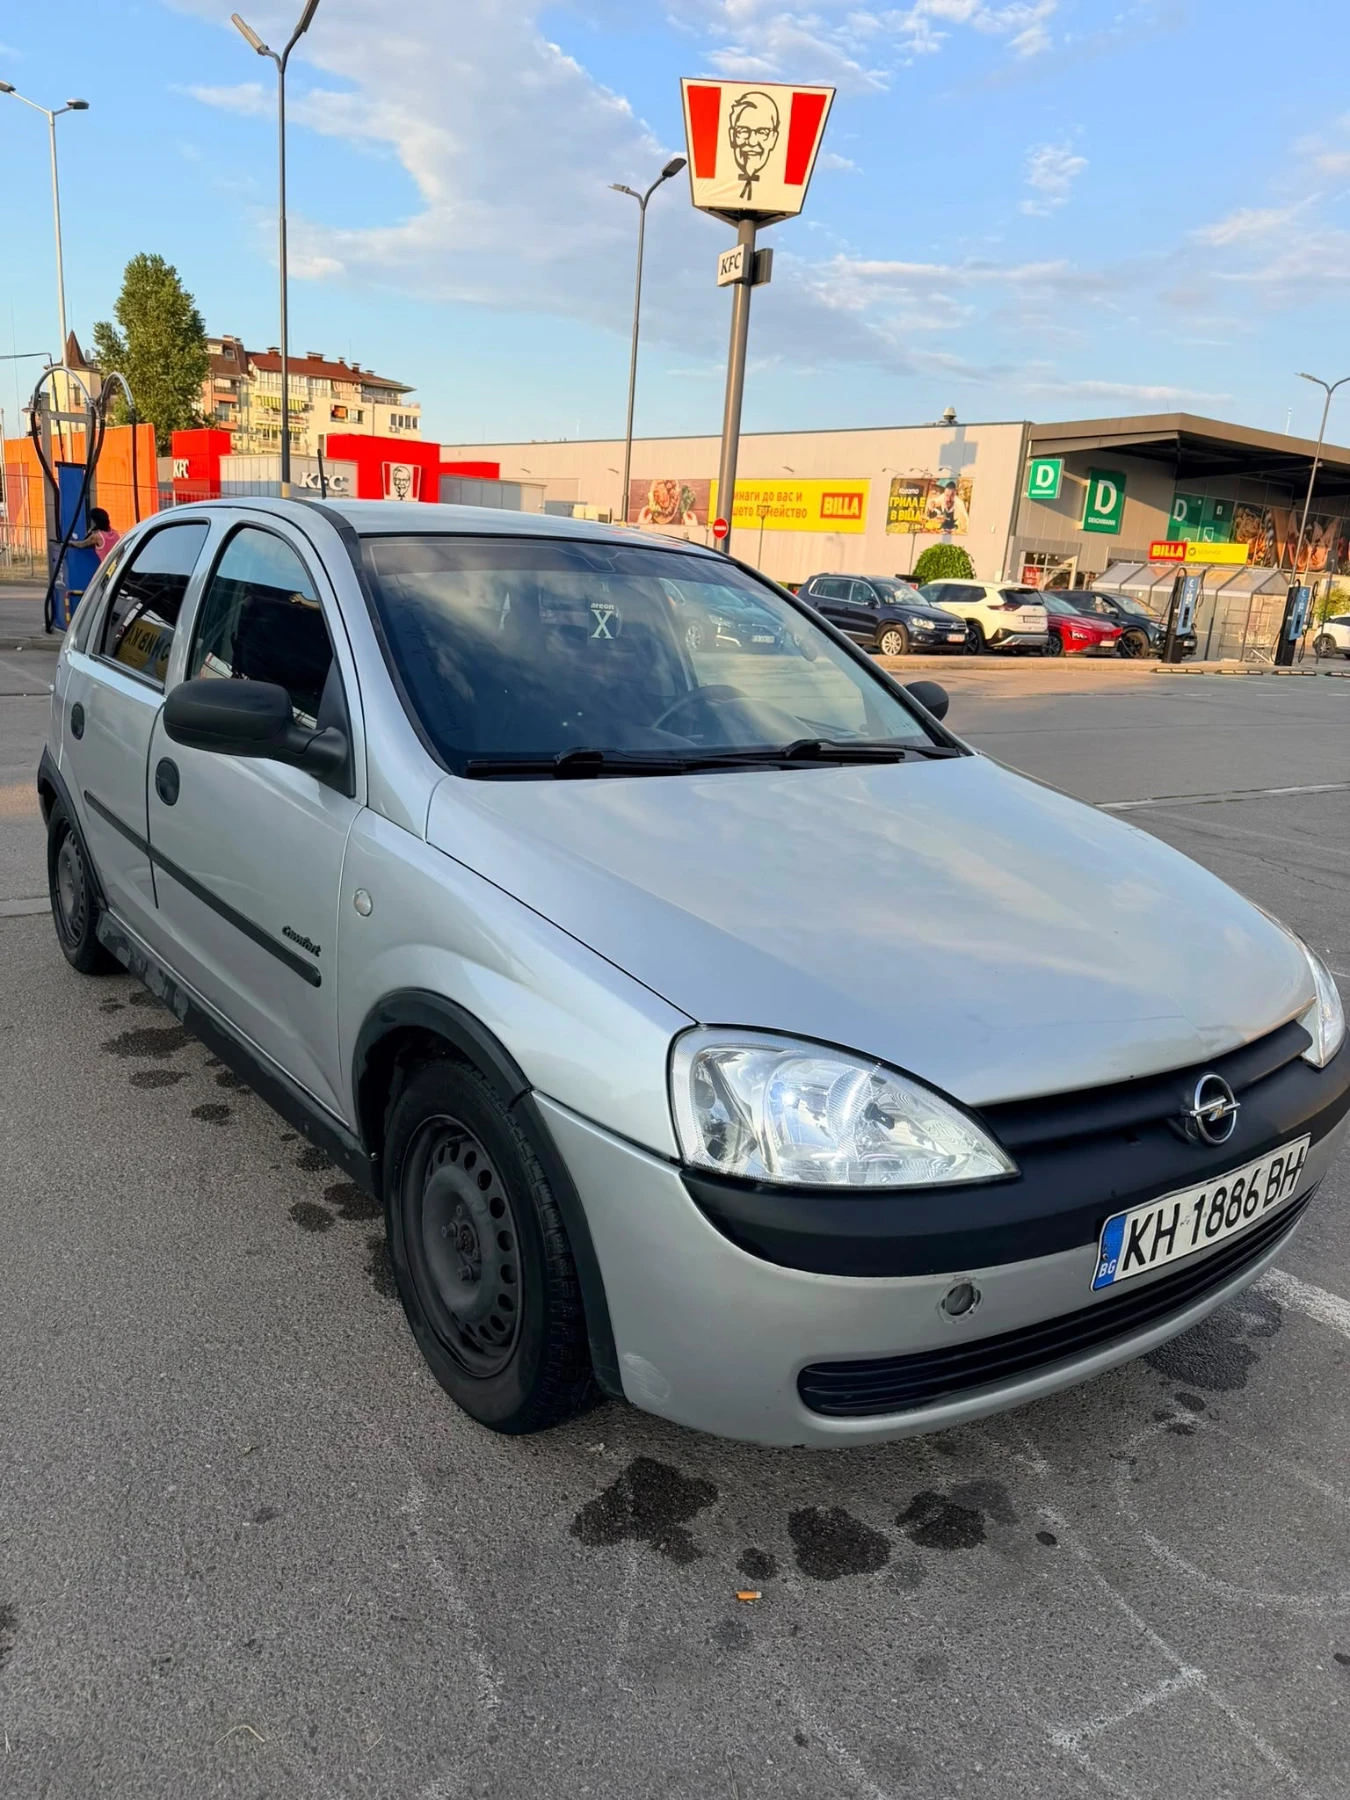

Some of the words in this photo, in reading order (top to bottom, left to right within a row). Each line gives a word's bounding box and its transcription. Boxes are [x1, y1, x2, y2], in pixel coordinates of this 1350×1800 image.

[720, 251, 742, 275] KFC
[173, 458, 189, 479] KFC
[299, 471, 344, 490] KFC
[733, 491, 760, 502] инаги
[762, 491, 774, 504] до
[777, 491, 794, 502] вас
[796, 491, 803, 502] и
[823, 496, 860, 516] BILLA
[889, 496, 918, 507] ГРИЛА
[1094, 479, 1117, 515] D
[731, 506, 754, 516] шето
[1151, 544, 1184, 558] BILLA
[590, 602, 615, 610] areon
[590, 609, 615, 640] X
[281, 925, 322, 957] Comfort
[1121, 1203, 1181, 1271] KH
[1190, 1168, 1262, 1247] 1886
[1263, 1146, 1304, 1209] BH
[1098, 1259, 1117, 1278] BG
